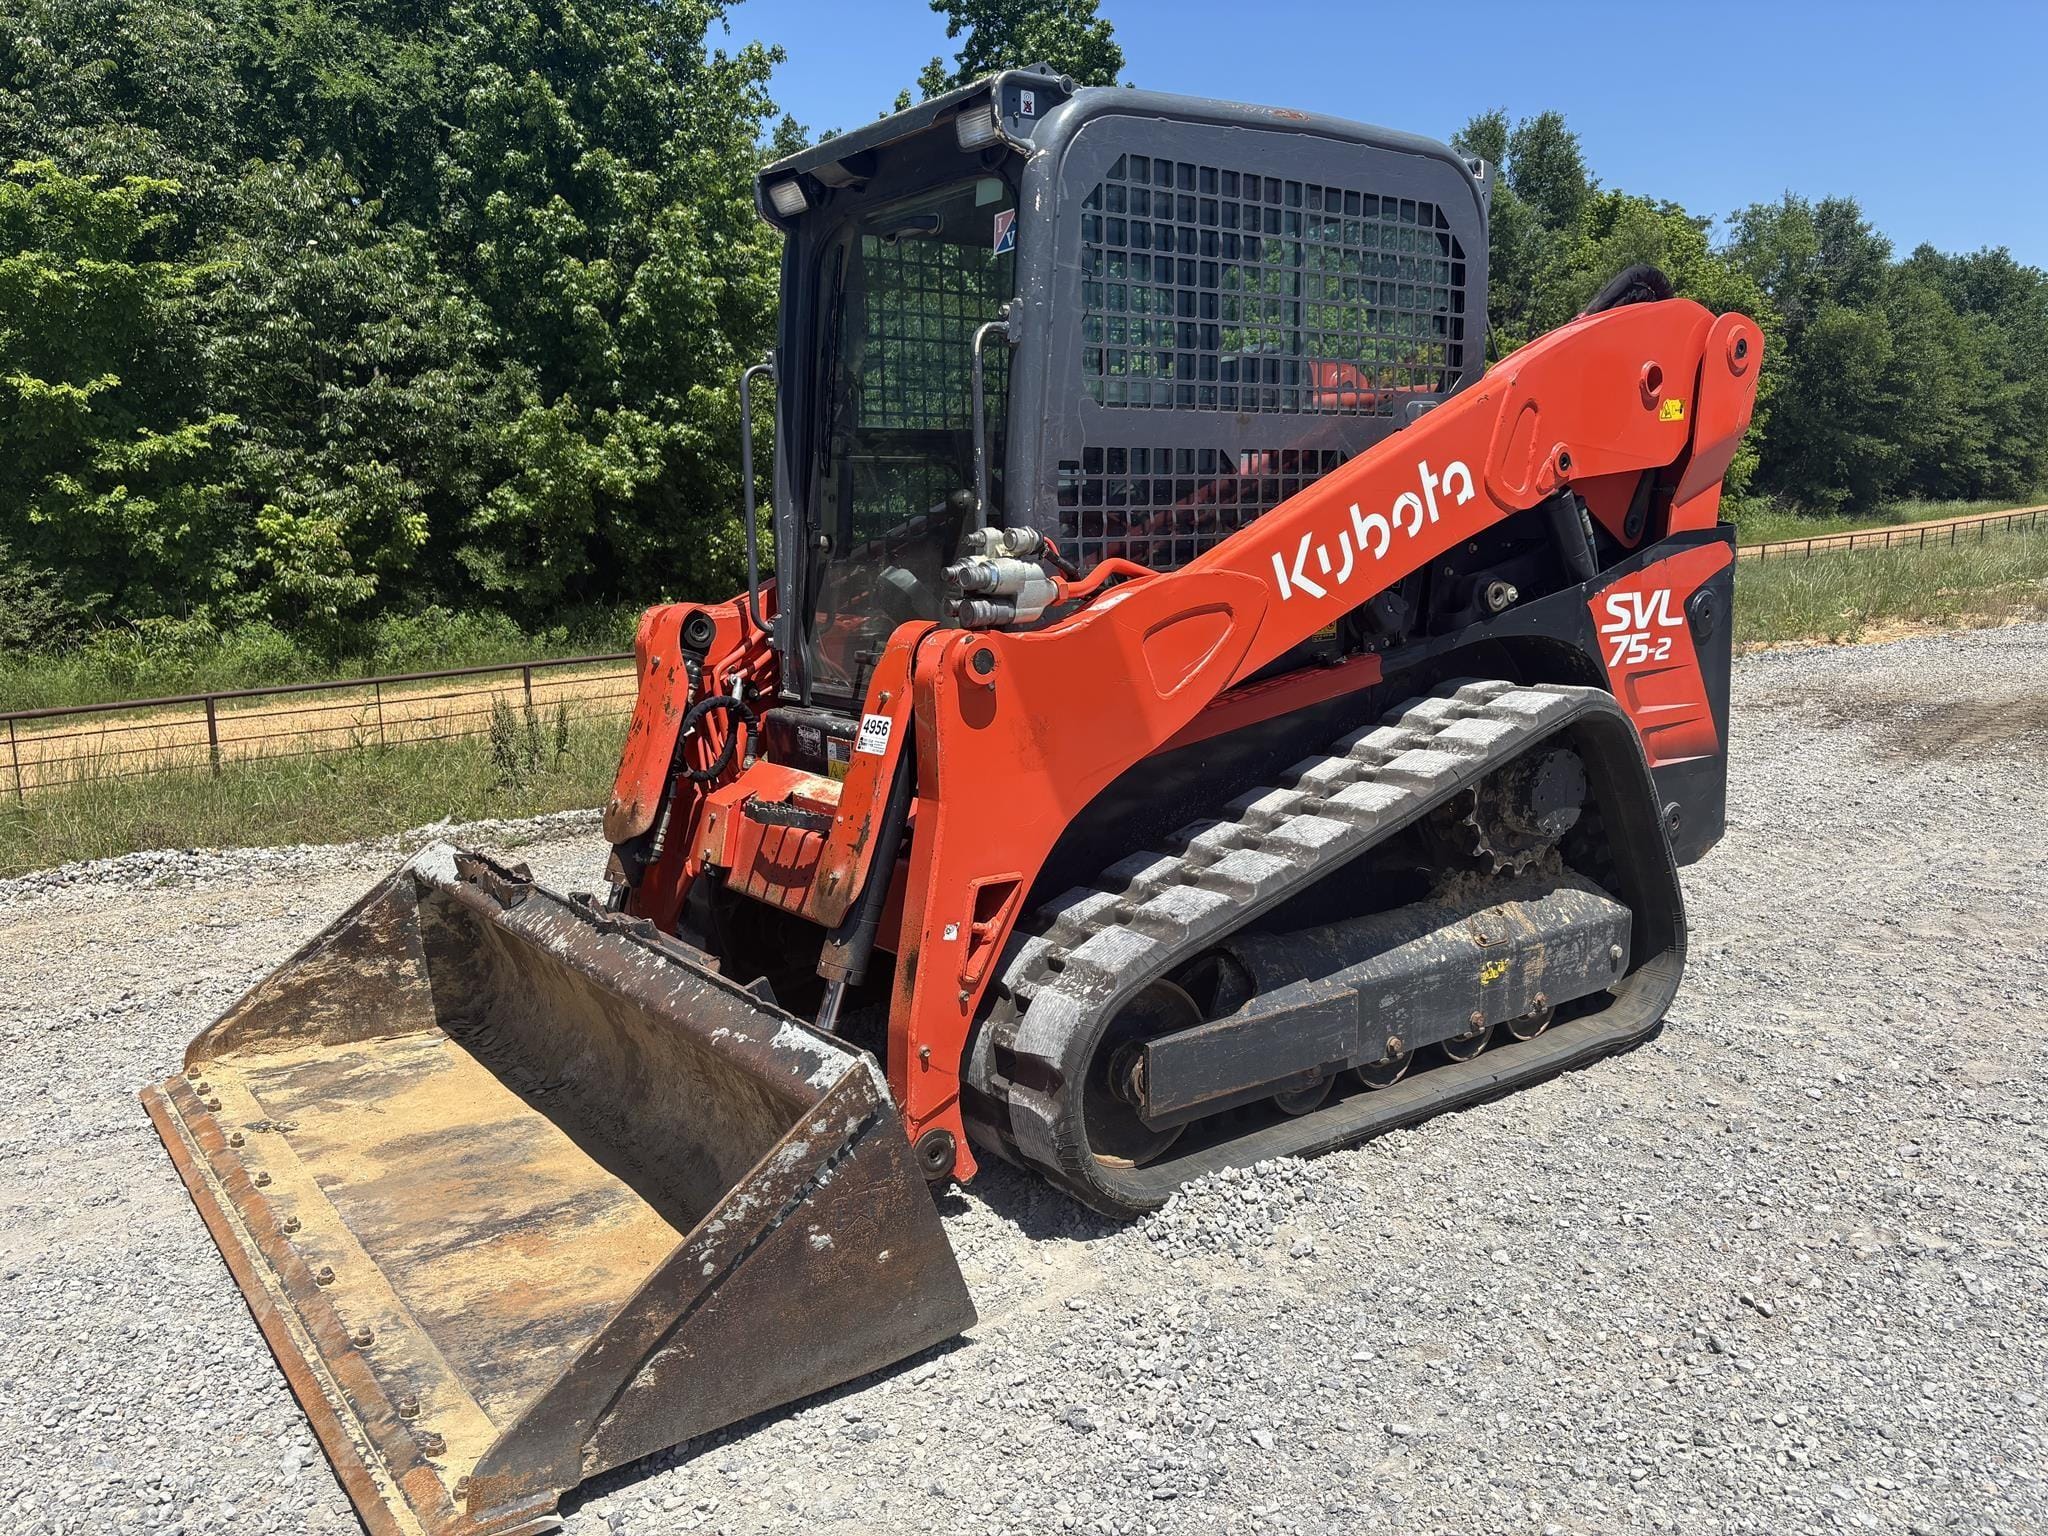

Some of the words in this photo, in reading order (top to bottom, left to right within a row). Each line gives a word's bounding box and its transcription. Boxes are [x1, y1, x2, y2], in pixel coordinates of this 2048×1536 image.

[1271, 459, 1475, 601] Kubota
[1601, 589, 1684, 634] SVL
[1608, 632, 1672, 668] 75-2
[863, 718, 890, 736] 4956
